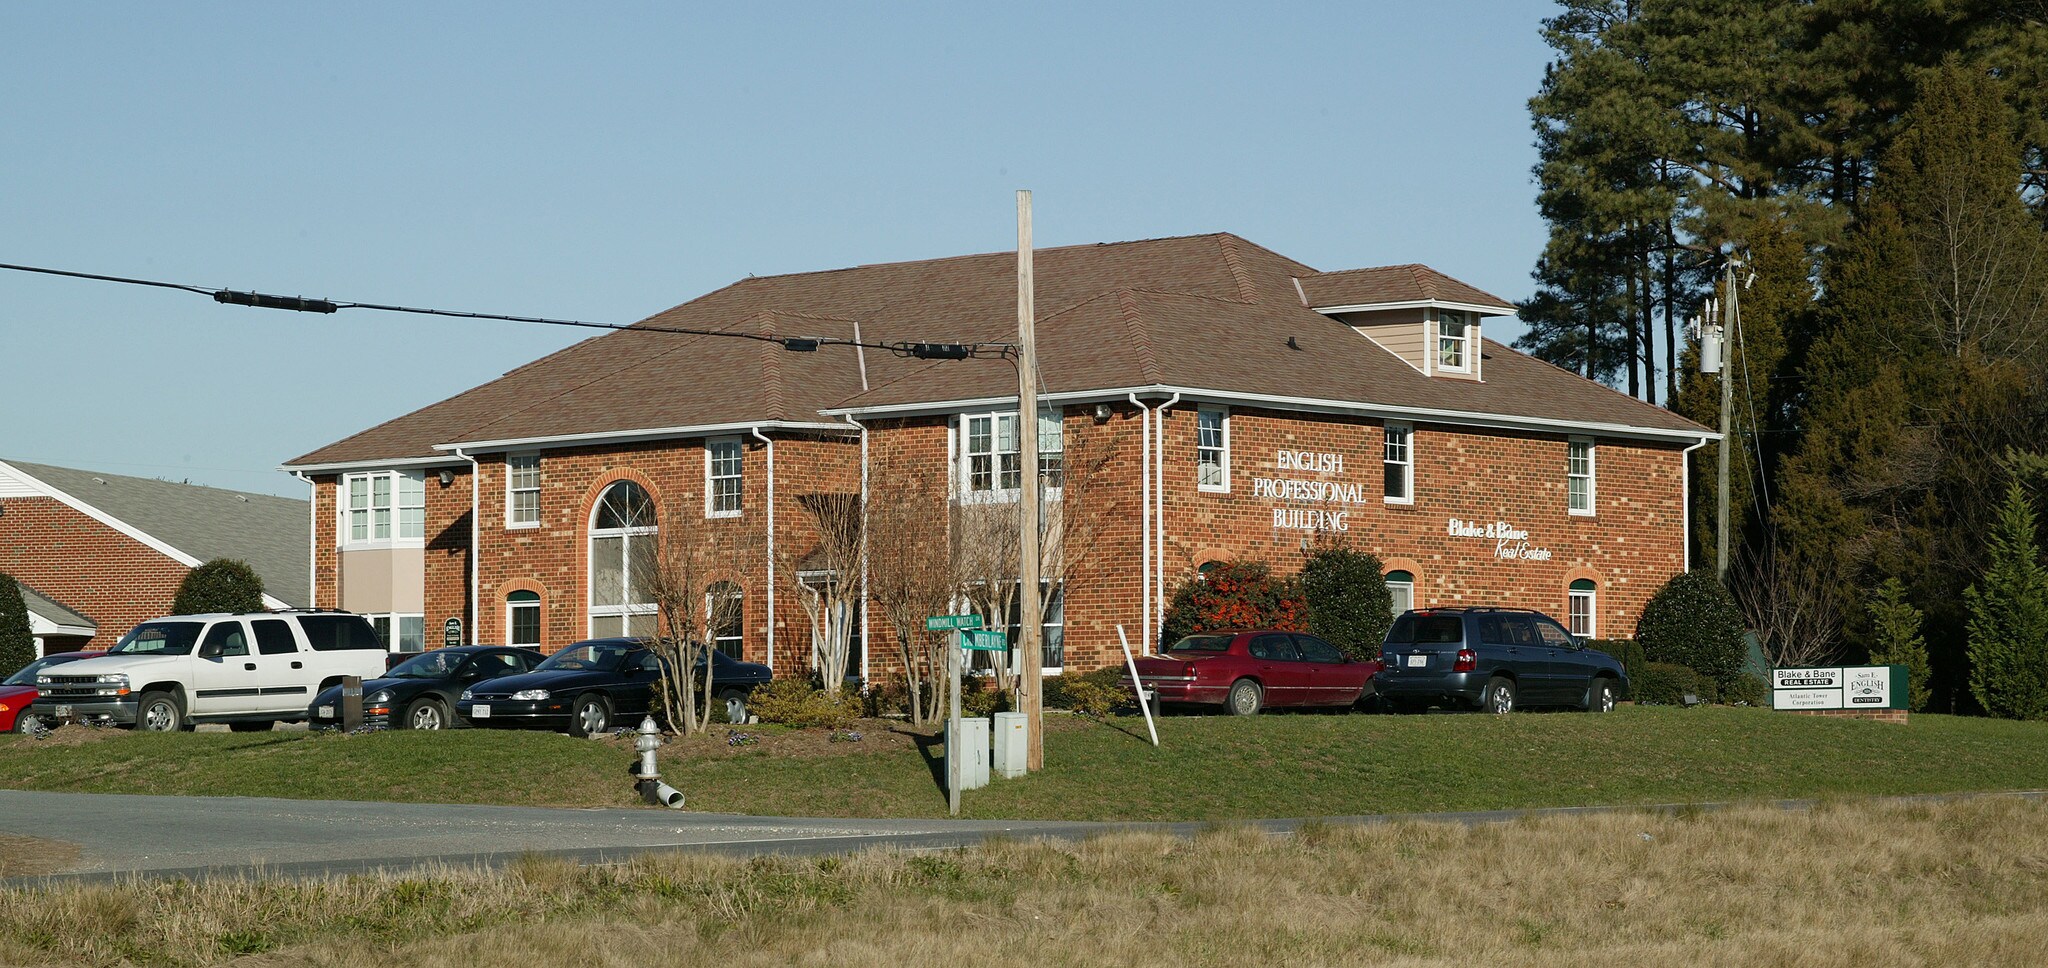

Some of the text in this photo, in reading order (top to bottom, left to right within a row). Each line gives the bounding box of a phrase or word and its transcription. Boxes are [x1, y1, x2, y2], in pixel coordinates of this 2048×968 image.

[1277, 450, 1344, 473] ENGLISH
[1253, 477, 1367, 504] PROFESSIONAL
[1272, 508, 1349, 532] BUILDING
[1449, 518, 1529, 540] Blake & Bane
[1494, 538, 1552, 561] Real Estate
[928, 617, 954, 628] WINDMILL
[956, 616, 974, 627] WATCH
[962, 632, 1002, 649] CMBERLAYNE
[1777, 670, 1802, 678] Blake
[1813, 669, 1836, 678] Bane
[1851, 680, 1884, 690] ENGLISH
